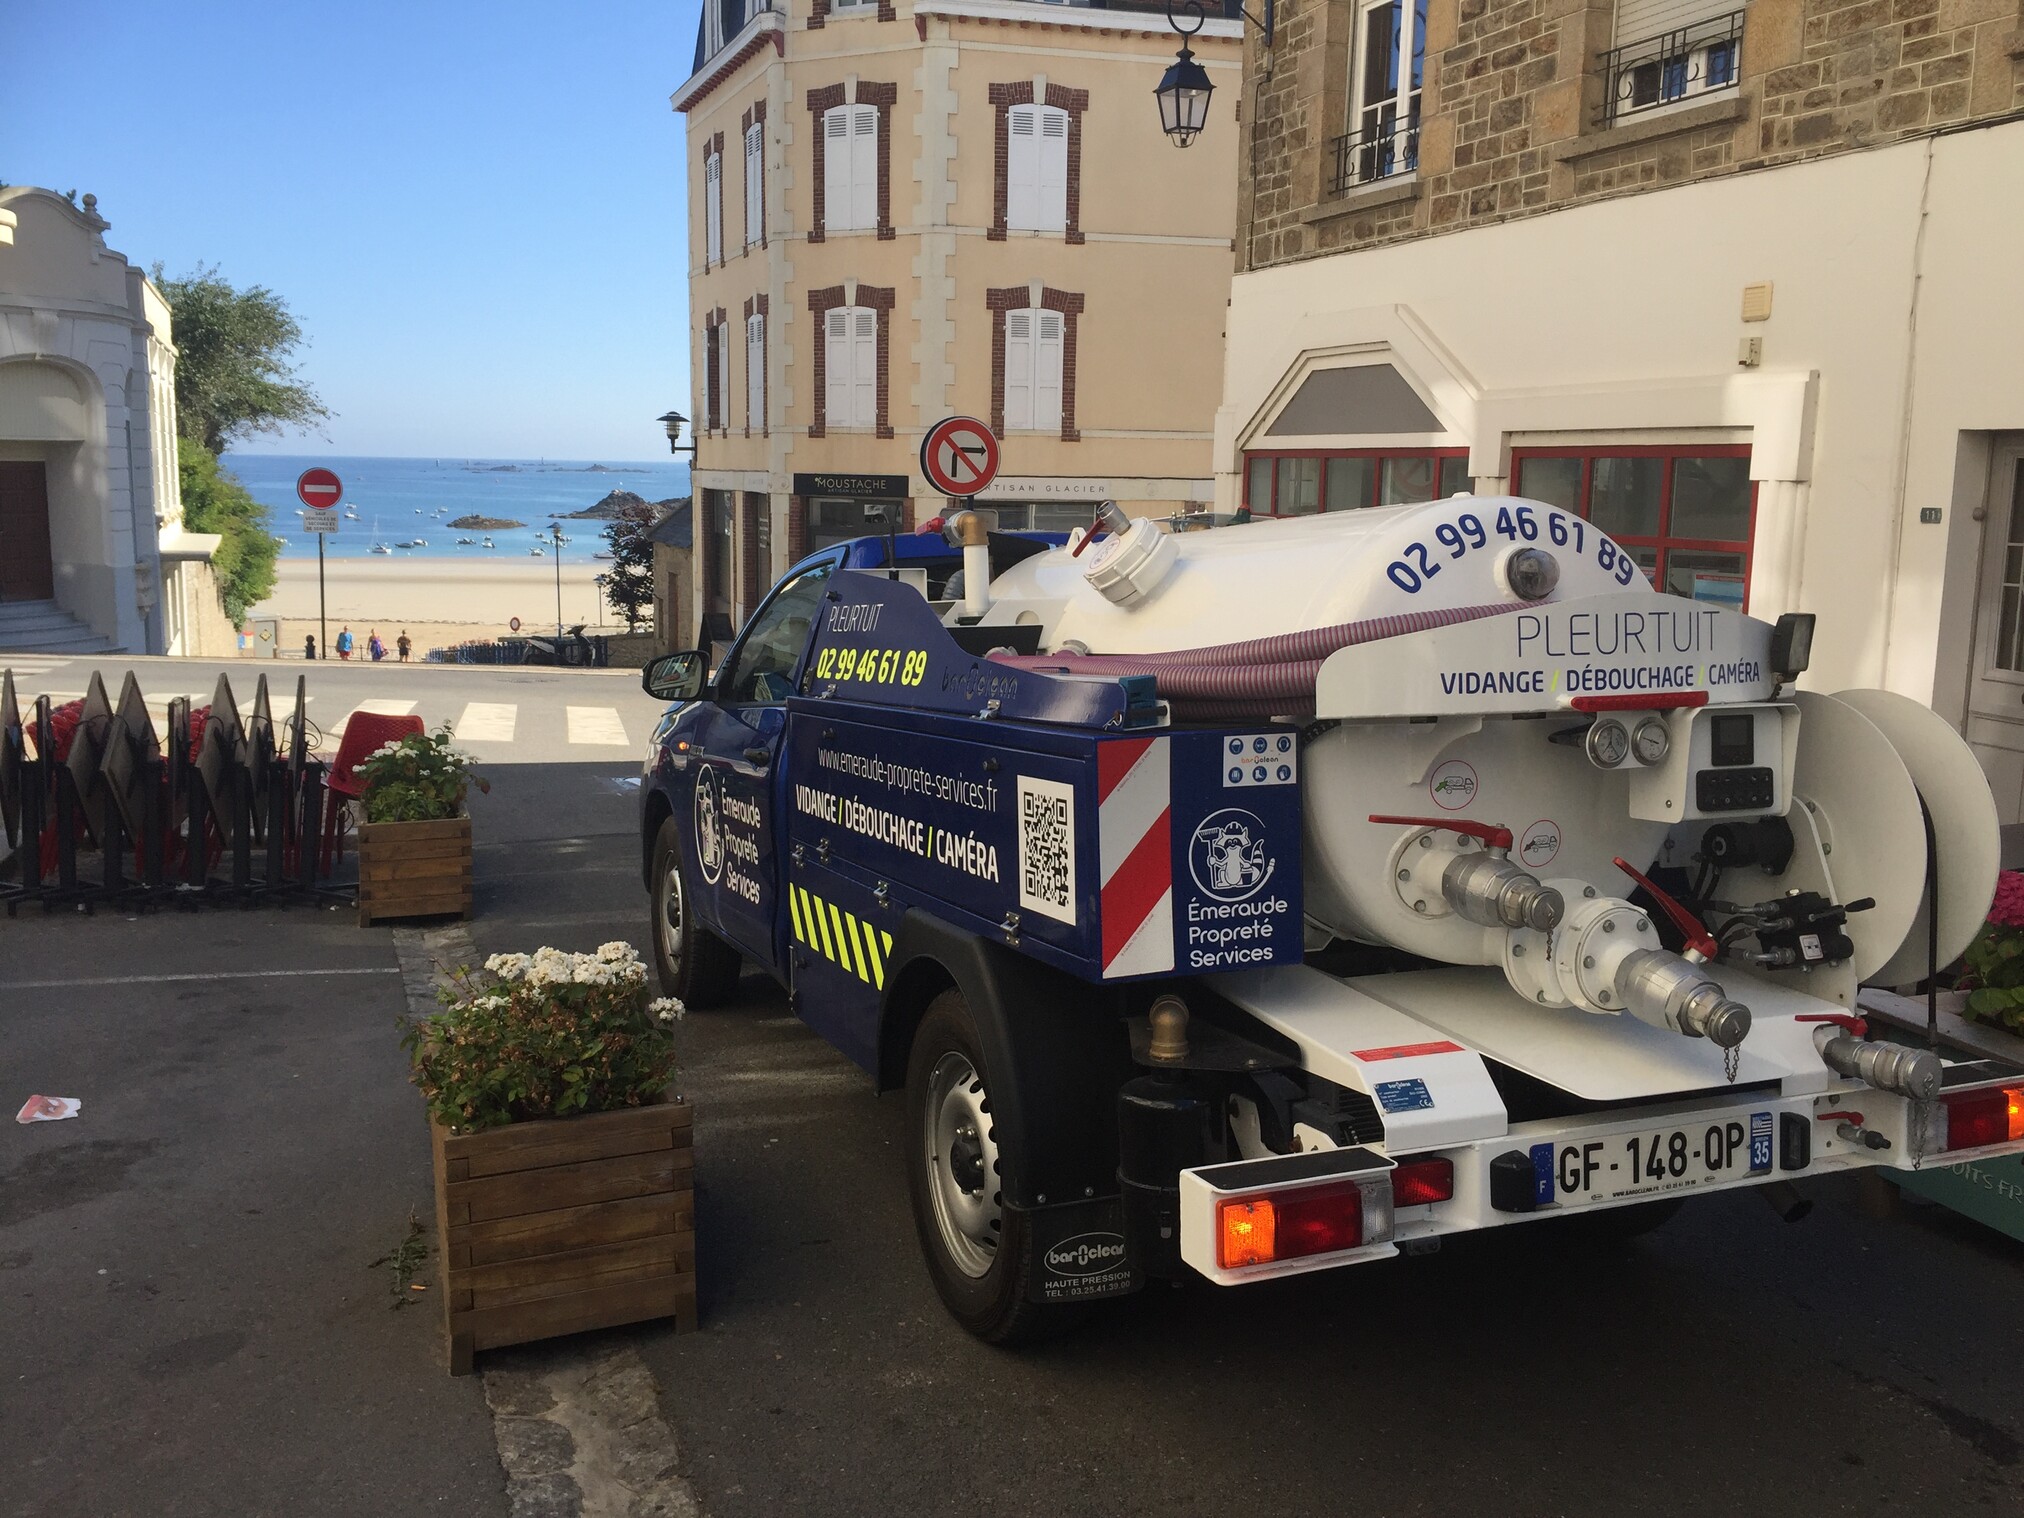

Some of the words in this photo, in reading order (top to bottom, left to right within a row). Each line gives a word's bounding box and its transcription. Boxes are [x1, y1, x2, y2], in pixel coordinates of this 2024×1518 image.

[817, 478, 887, 490] MOUSTACHE
[985, 484, 1035, 492] RTISAN
[1045, 484, 1105, 493] GLACIER
[1386, 542, 1442, 594] 02
[1435, 513, 1487, 560] 99
[1495, 506, 1539, 541] 46
[1548, 512, 1584, 554] 61
[1597, 538, 1634, 586] 89
[827, 604, 884, 632] PLEURTUIT
[1517, 611, 1720, 658] PLEURTUIT
[816, 648, 837, 679] 02
[835, 648, 857, 681] 99
[856, 650, 879, 682] 46
[878, 650, 901, 684] 61
[901, 650, 928, 686] 89
[1441, 670, 1544, 695] VIDANGE
[1566, 664, 1694, 691] DÉBOUCHAGE
[1709, 657, 1760, 686] CAMÉRA
[818, 747, 998, 812] www.emeraude-proprete-services.fr
[721, 778, 760, 829] Émeraude
[724, 824, 759, 865] Propreté
[796, 784, 837, 824] VIDANGE
[845, 795, 924, 856] DÉBOUCHAGE
[936, 830, 999, 884] CAMÉRA
[726, 861, 760, 904] Services
[1188, 895, 1288, 922] Émeraude
[1188, 918, 1273, 948] Propreté
[1190, 946, 1273, 968] Services
[1539, 1180, 1547, 1194] F
[1560, 1122, 1745, 1194] GF-148-QP
[1754, 1141, 1769, 1164] 35
[1045, 1278, 1080, 1288] HAUTE
[1082, 1271, 1130, 1285] PRESSION
